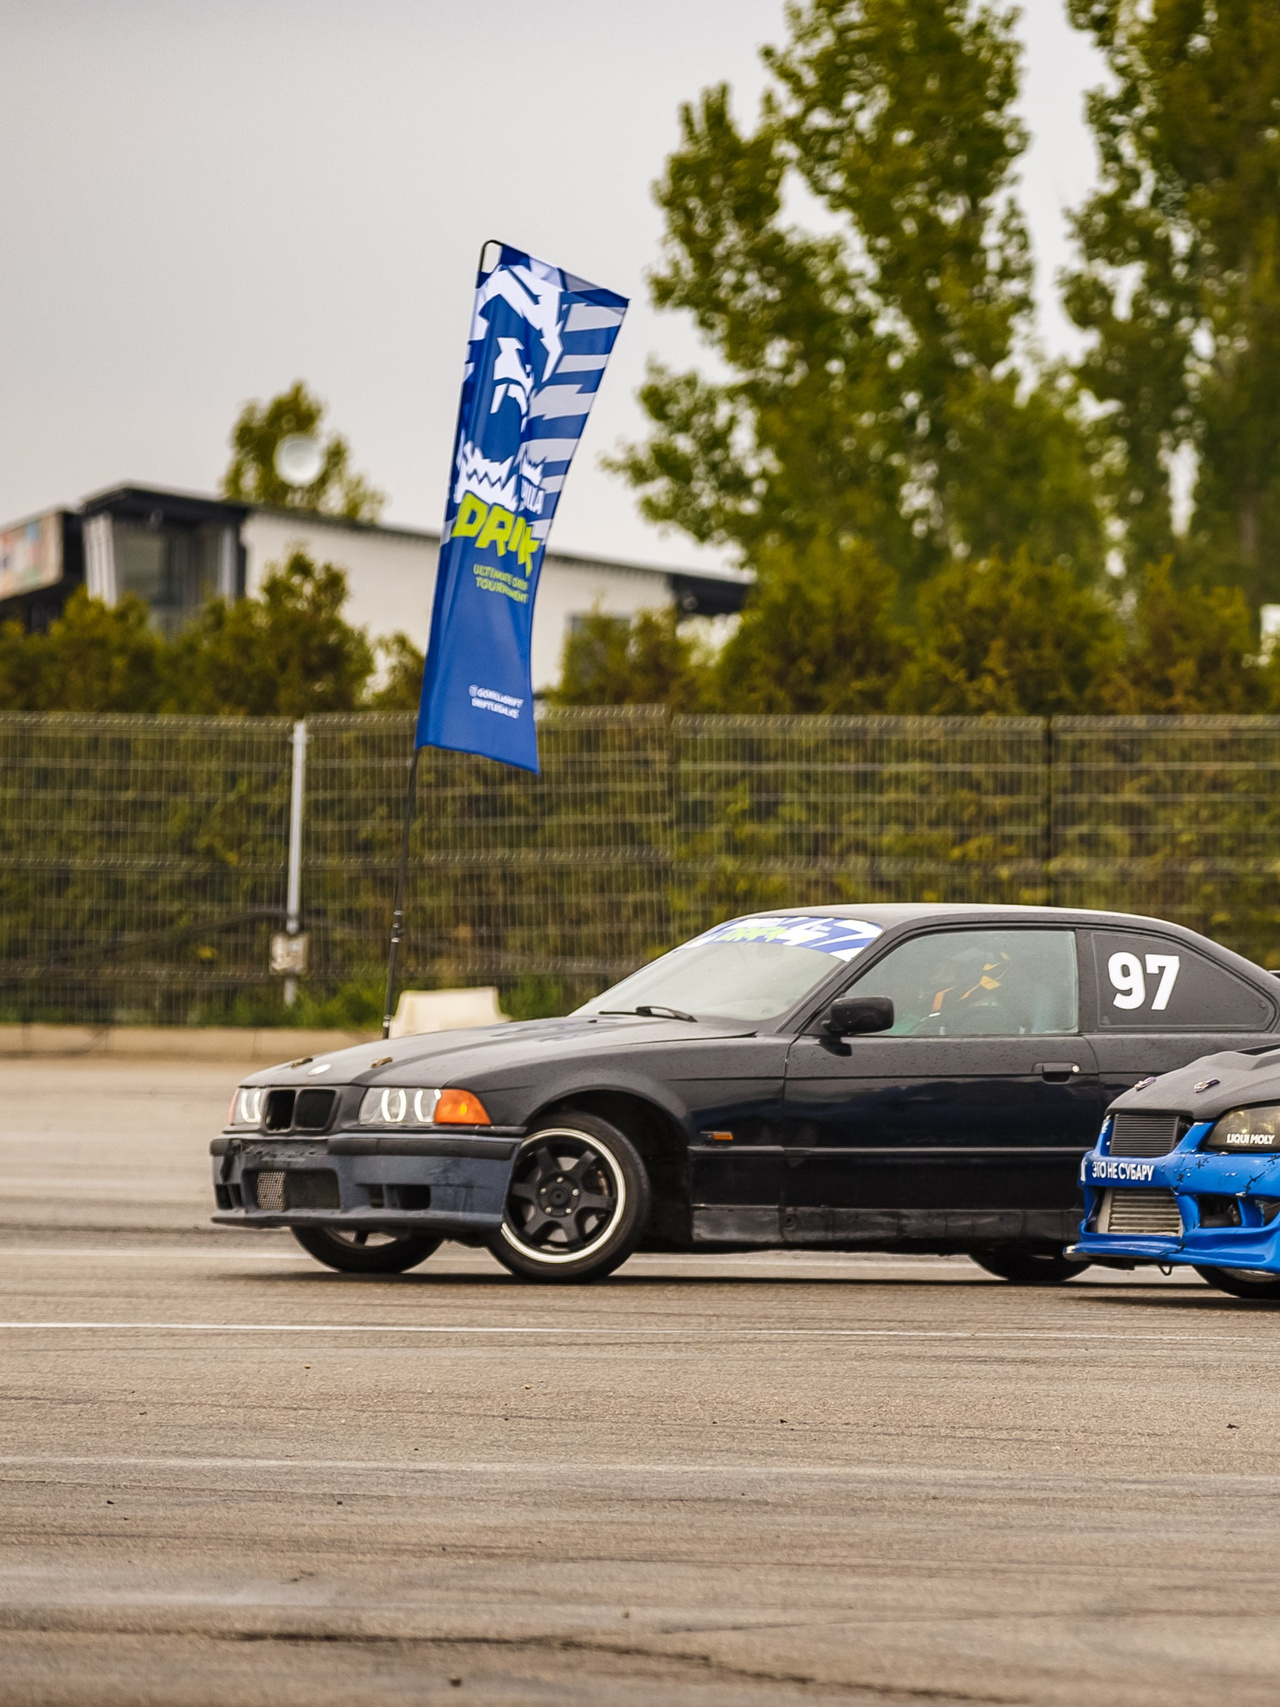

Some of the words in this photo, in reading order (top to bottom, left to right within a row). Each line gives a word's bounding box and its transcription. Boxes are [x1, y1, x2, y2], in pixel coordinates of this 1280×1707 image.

[1107, 951, 1180, 1010] 97
[1226, 1133, 1250, 1144] LIQUI
[1250, 1134, 1275, 1145] MOLY
[1092, 1161, 1107, 1178] ЭТО
[1107, 1162, 1118, 1179] НЕ
[1118, 1163, 1155, 1182] СУБАРУ
